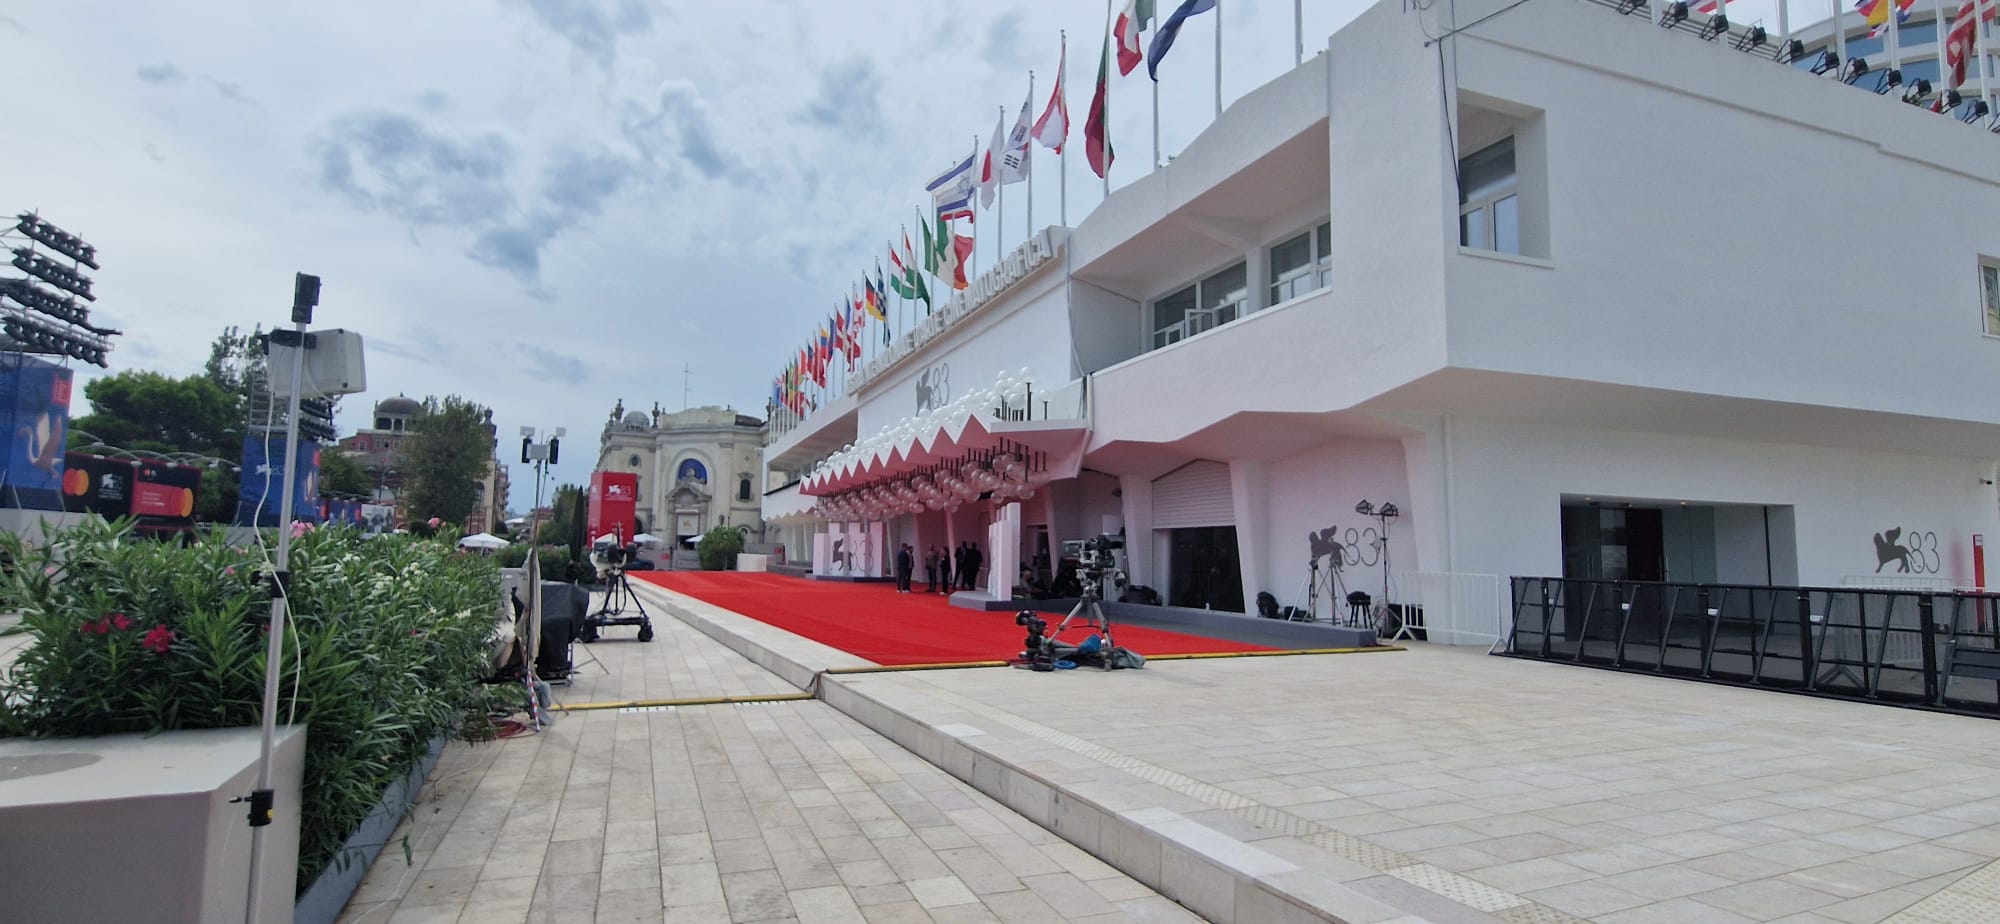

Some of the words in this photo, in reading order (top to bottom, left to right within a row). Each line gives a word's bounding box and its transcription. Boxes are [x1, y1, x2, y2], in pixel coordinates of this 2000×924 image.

[932, 362, 950, 410] 83
[1343, 527, 1379, 566] 83
[1909, 531, 1940, 574] 83
